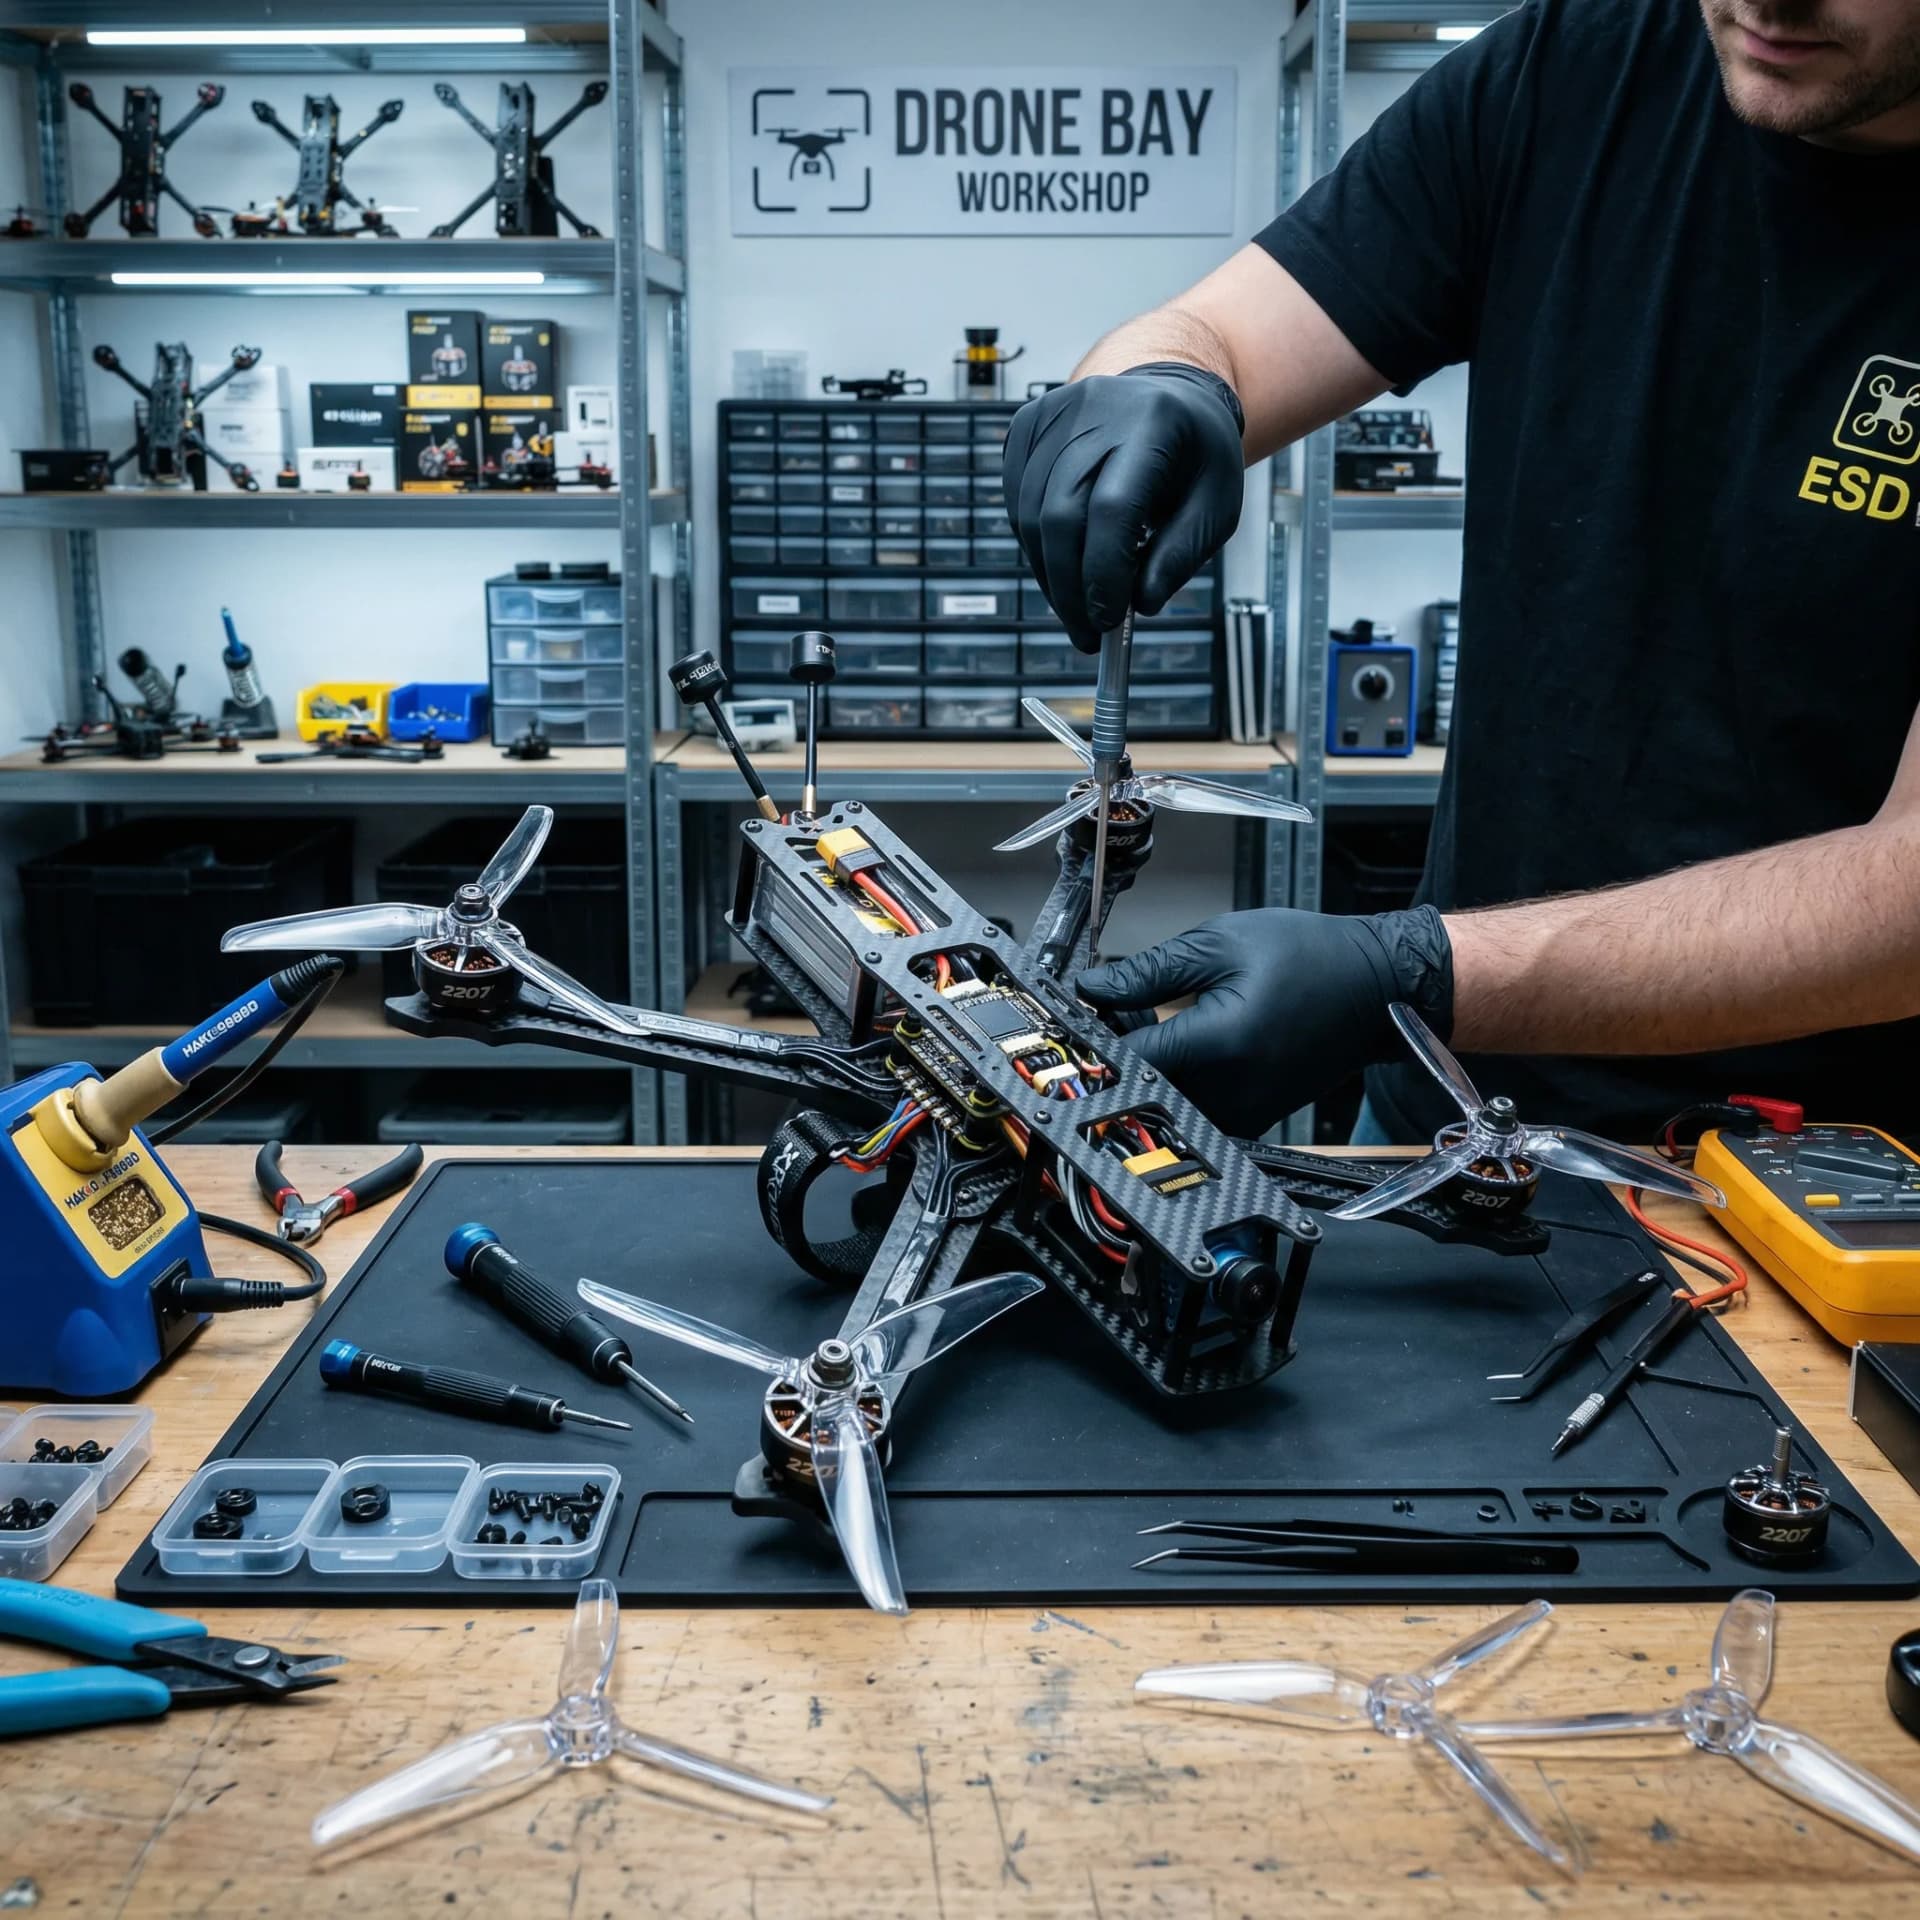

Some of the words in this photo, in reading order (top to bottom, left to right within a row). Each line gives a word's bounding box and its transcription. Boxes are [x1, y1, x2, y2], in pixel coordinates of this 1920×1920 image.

[896, 88, 1082, 156] DRONE
[1102, 88, 1214, 156] BAY
[957, 171, 1150, 212] WORKSHOP
[1798, 455, 1910, 520] ESD
[1461, 1188, 1512, 1208] 2207
[1759, 1526, 1813, 1543] 2207
